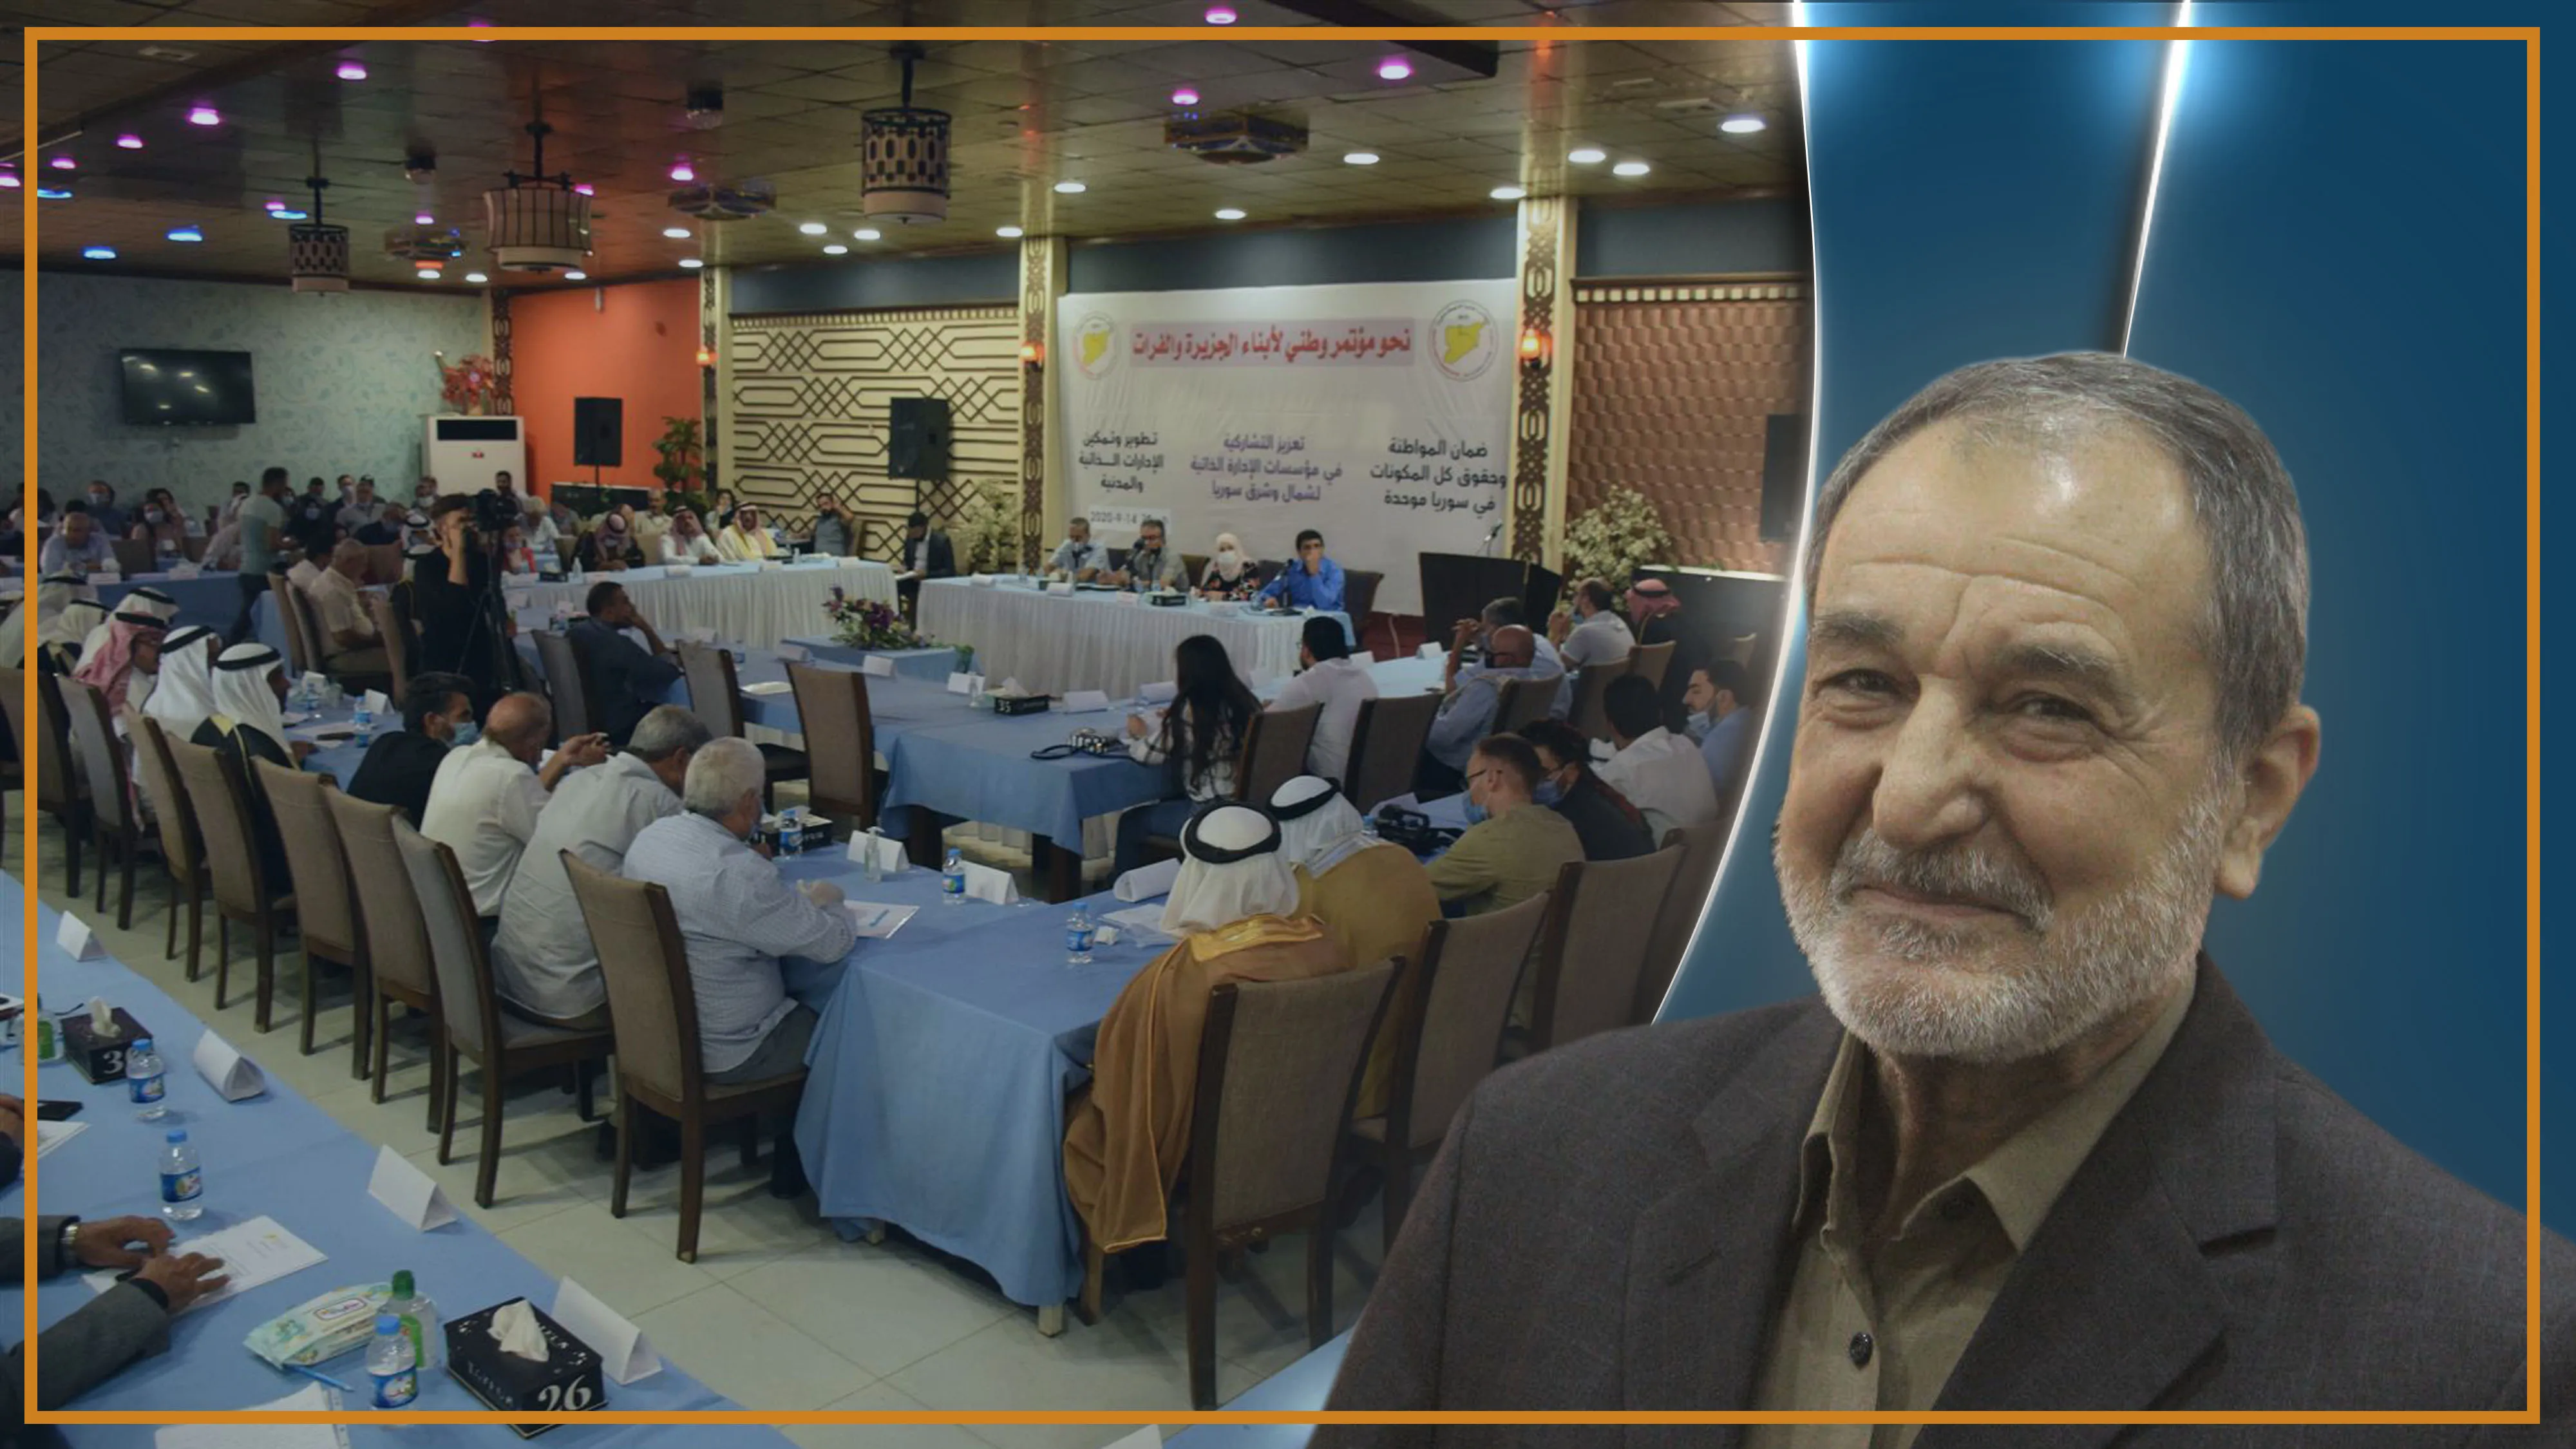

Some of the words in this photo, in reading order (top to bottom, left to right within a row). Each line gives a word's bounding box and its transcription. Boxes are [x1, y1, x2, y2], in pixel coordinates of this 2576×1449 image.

[1132, 331, 1182, 361] والفرات
[1185, 331, 1238, 361] الجزيرة
[1242, 324, 1283, 361] لأبناء
[1285, 329, 1327, 363] وطني
[1329, 327, 1375, 359] مؤتمر
[1376, 328, 1411, 359] نحو
[1083, 430, 1122, 448] وتمكين
[1124, 431, 1158, 450] تطوير
[1224, 433, 1274, 452] التشاركية
[1388, 437, 1446, 459] المواطنة
[1450, 440, 1488, 460] ضمان
[1123, 453, 1164, 475] الإدارات
[1190, 455, 1224, 475] الذاتية
[1227, 457, 1262, 480] الإدارة
[1264, 459, 1319, 480] مؤسسات
[1323, 462, 1343, 486] في
[1370, 463, 1430, 483] المكونات
[1101, 473, 1144, 494] والمدنية
[1434, 466, 1453, 486] كل
[1457, 467, 1508, 489] وحقوق
[1211, 480, 1243, 500] سوريا
[1245, 482, 1279, 502] وشرق
[1282, 484, 1321, 503] لشمال
[1384, 489, 1427, 510] موحدة
[1431, 491, 1469, 513] سوريا
[1472, 495, 1495, 520] في
[537, 1374, 592, 1412] 26
